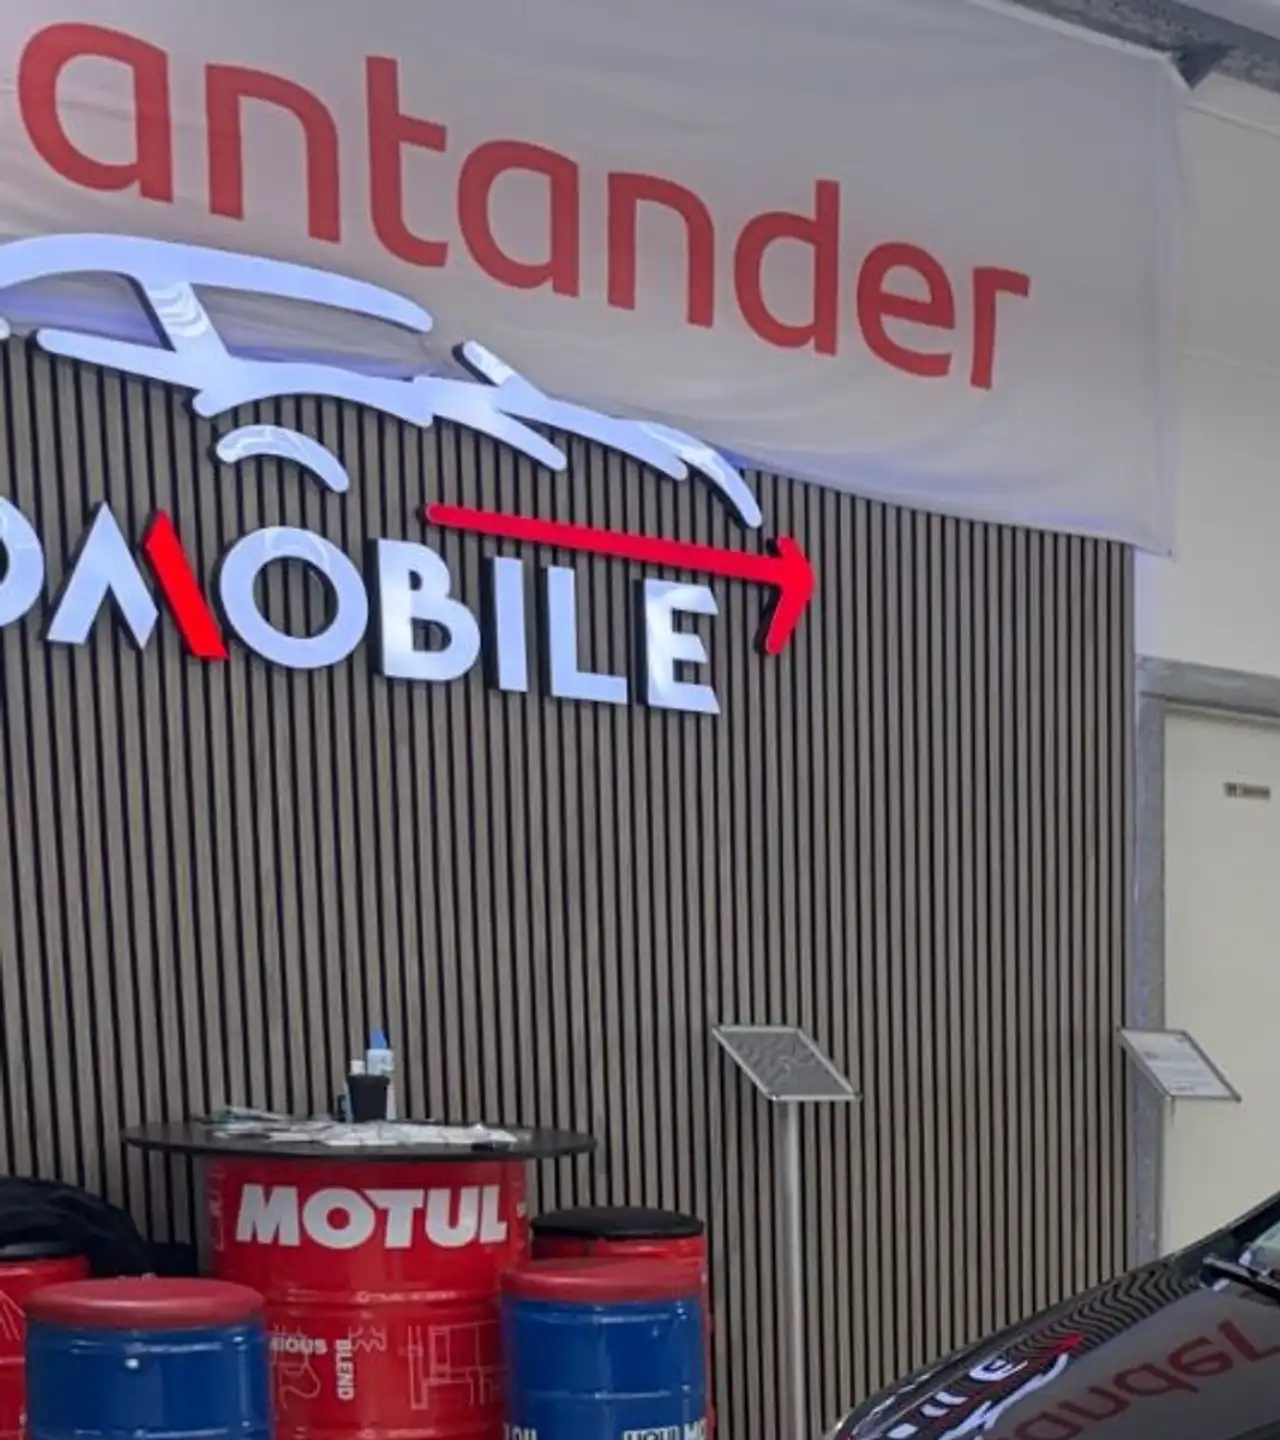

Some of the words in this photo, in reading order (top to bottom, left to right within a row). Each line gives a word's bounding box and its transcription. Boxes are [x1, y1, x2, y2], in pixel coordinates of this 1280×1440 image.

[18, 22, 1031, 389] antander
[235, 1183, 508, 1250] MOTUL
[335, 1338, 355, 1401] BLEND
